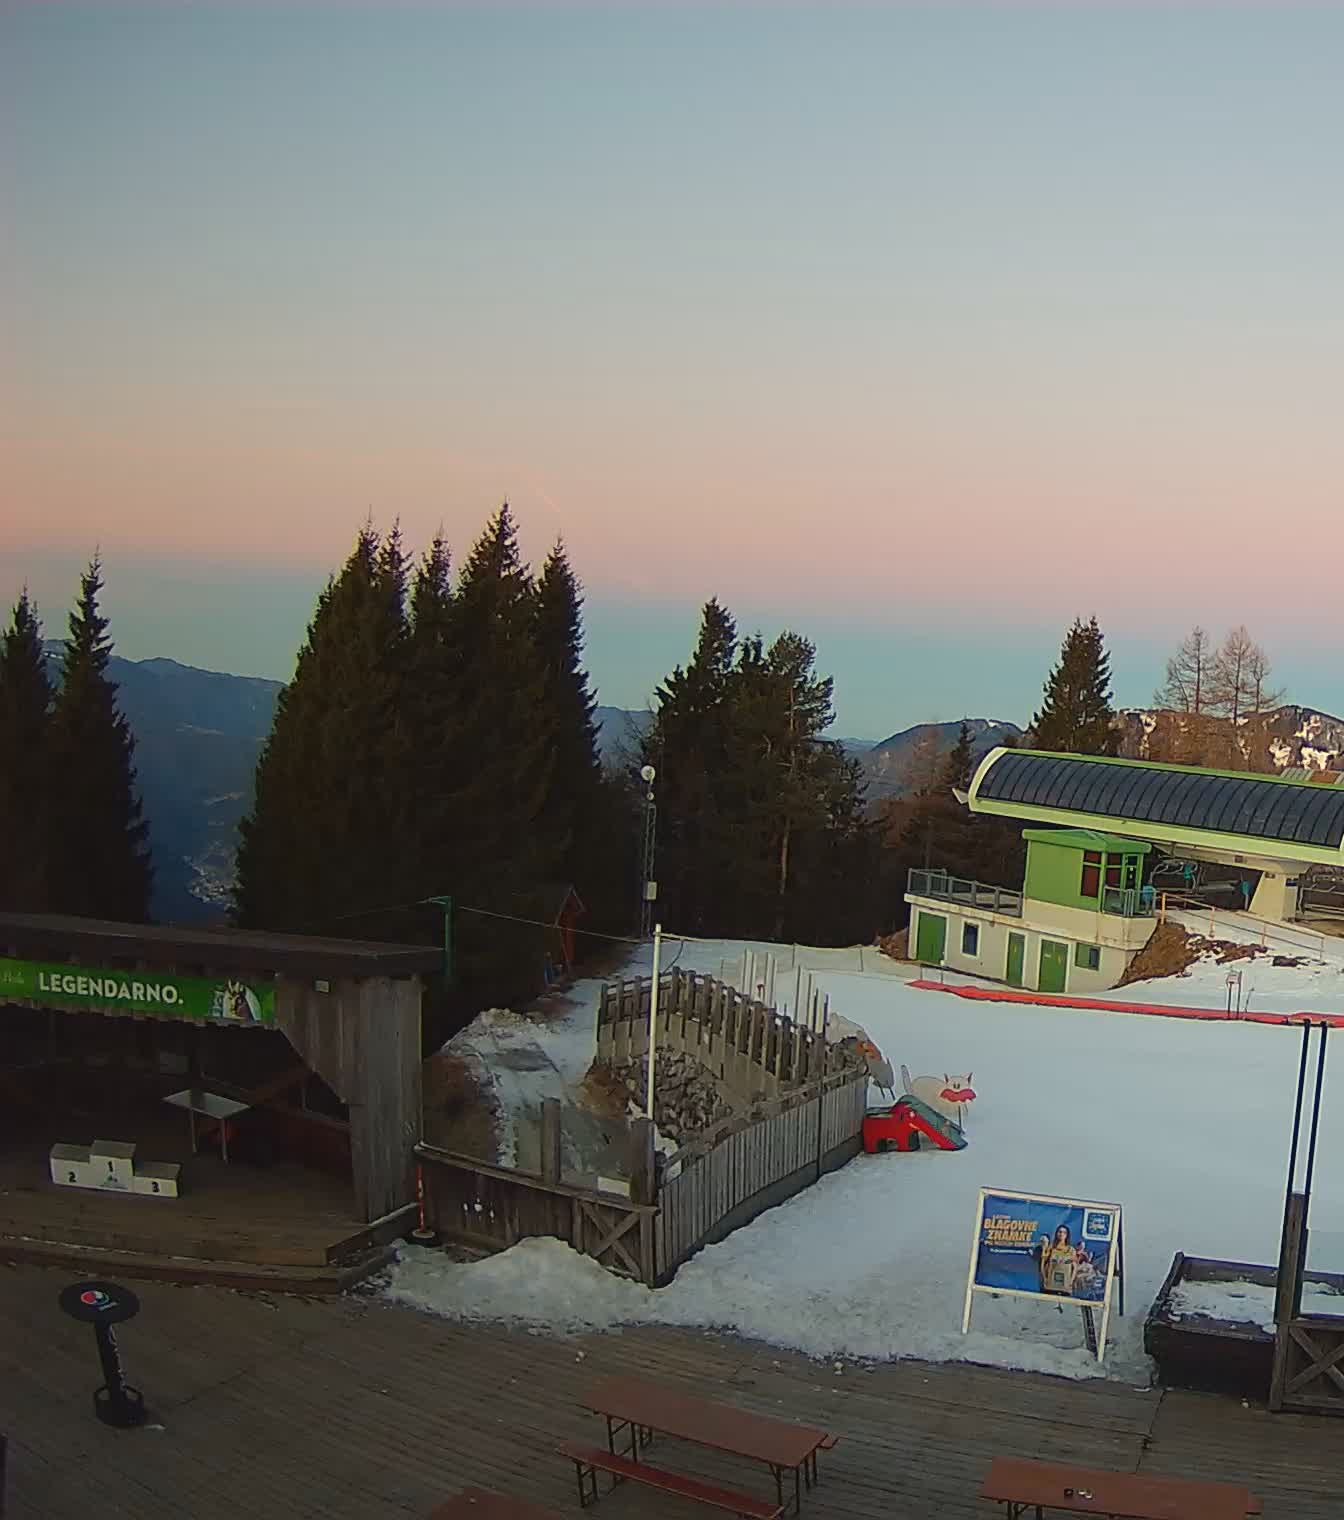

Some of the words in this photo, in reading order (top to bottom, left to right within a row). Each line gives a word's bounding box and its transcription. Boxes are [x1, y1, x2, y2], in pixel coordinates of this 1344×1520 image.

[39, 972, 184, 1004] LEGENDARNO.
[69, 1172, 77, 1183] 2
[152, 1181, 160, 1193] 3
[984, 1218, 1038, 1231] BLAGOVNE
